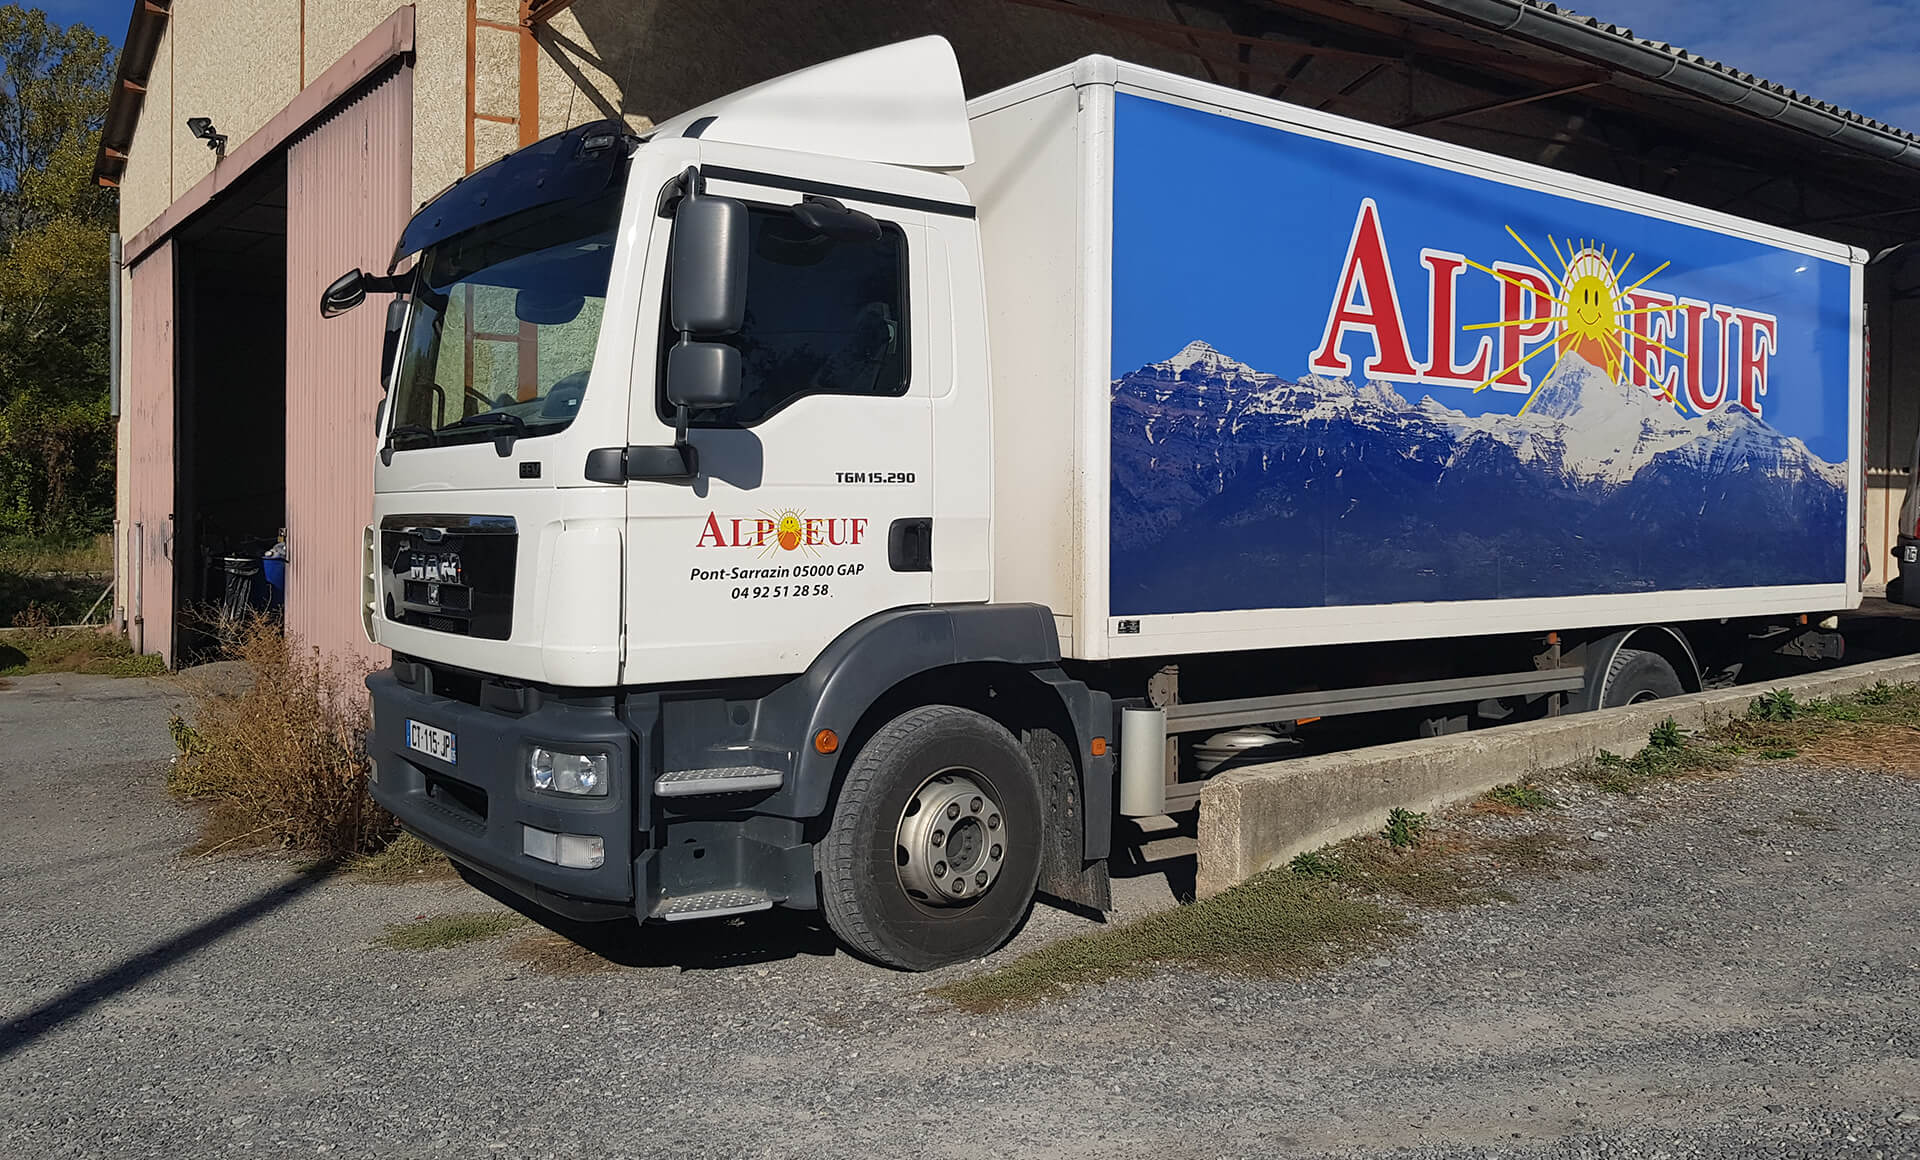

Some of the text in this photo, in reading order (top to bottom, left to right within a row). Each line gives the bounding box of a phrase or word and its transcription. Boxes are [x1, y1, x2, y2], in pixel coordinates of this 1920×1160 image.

[410, 553, 460, 583] MAN
[690, 563, 865, 580] Pont-Sarrazin 05000 GAP
[731, 584, 829, 599] 04 92 51 28 58
